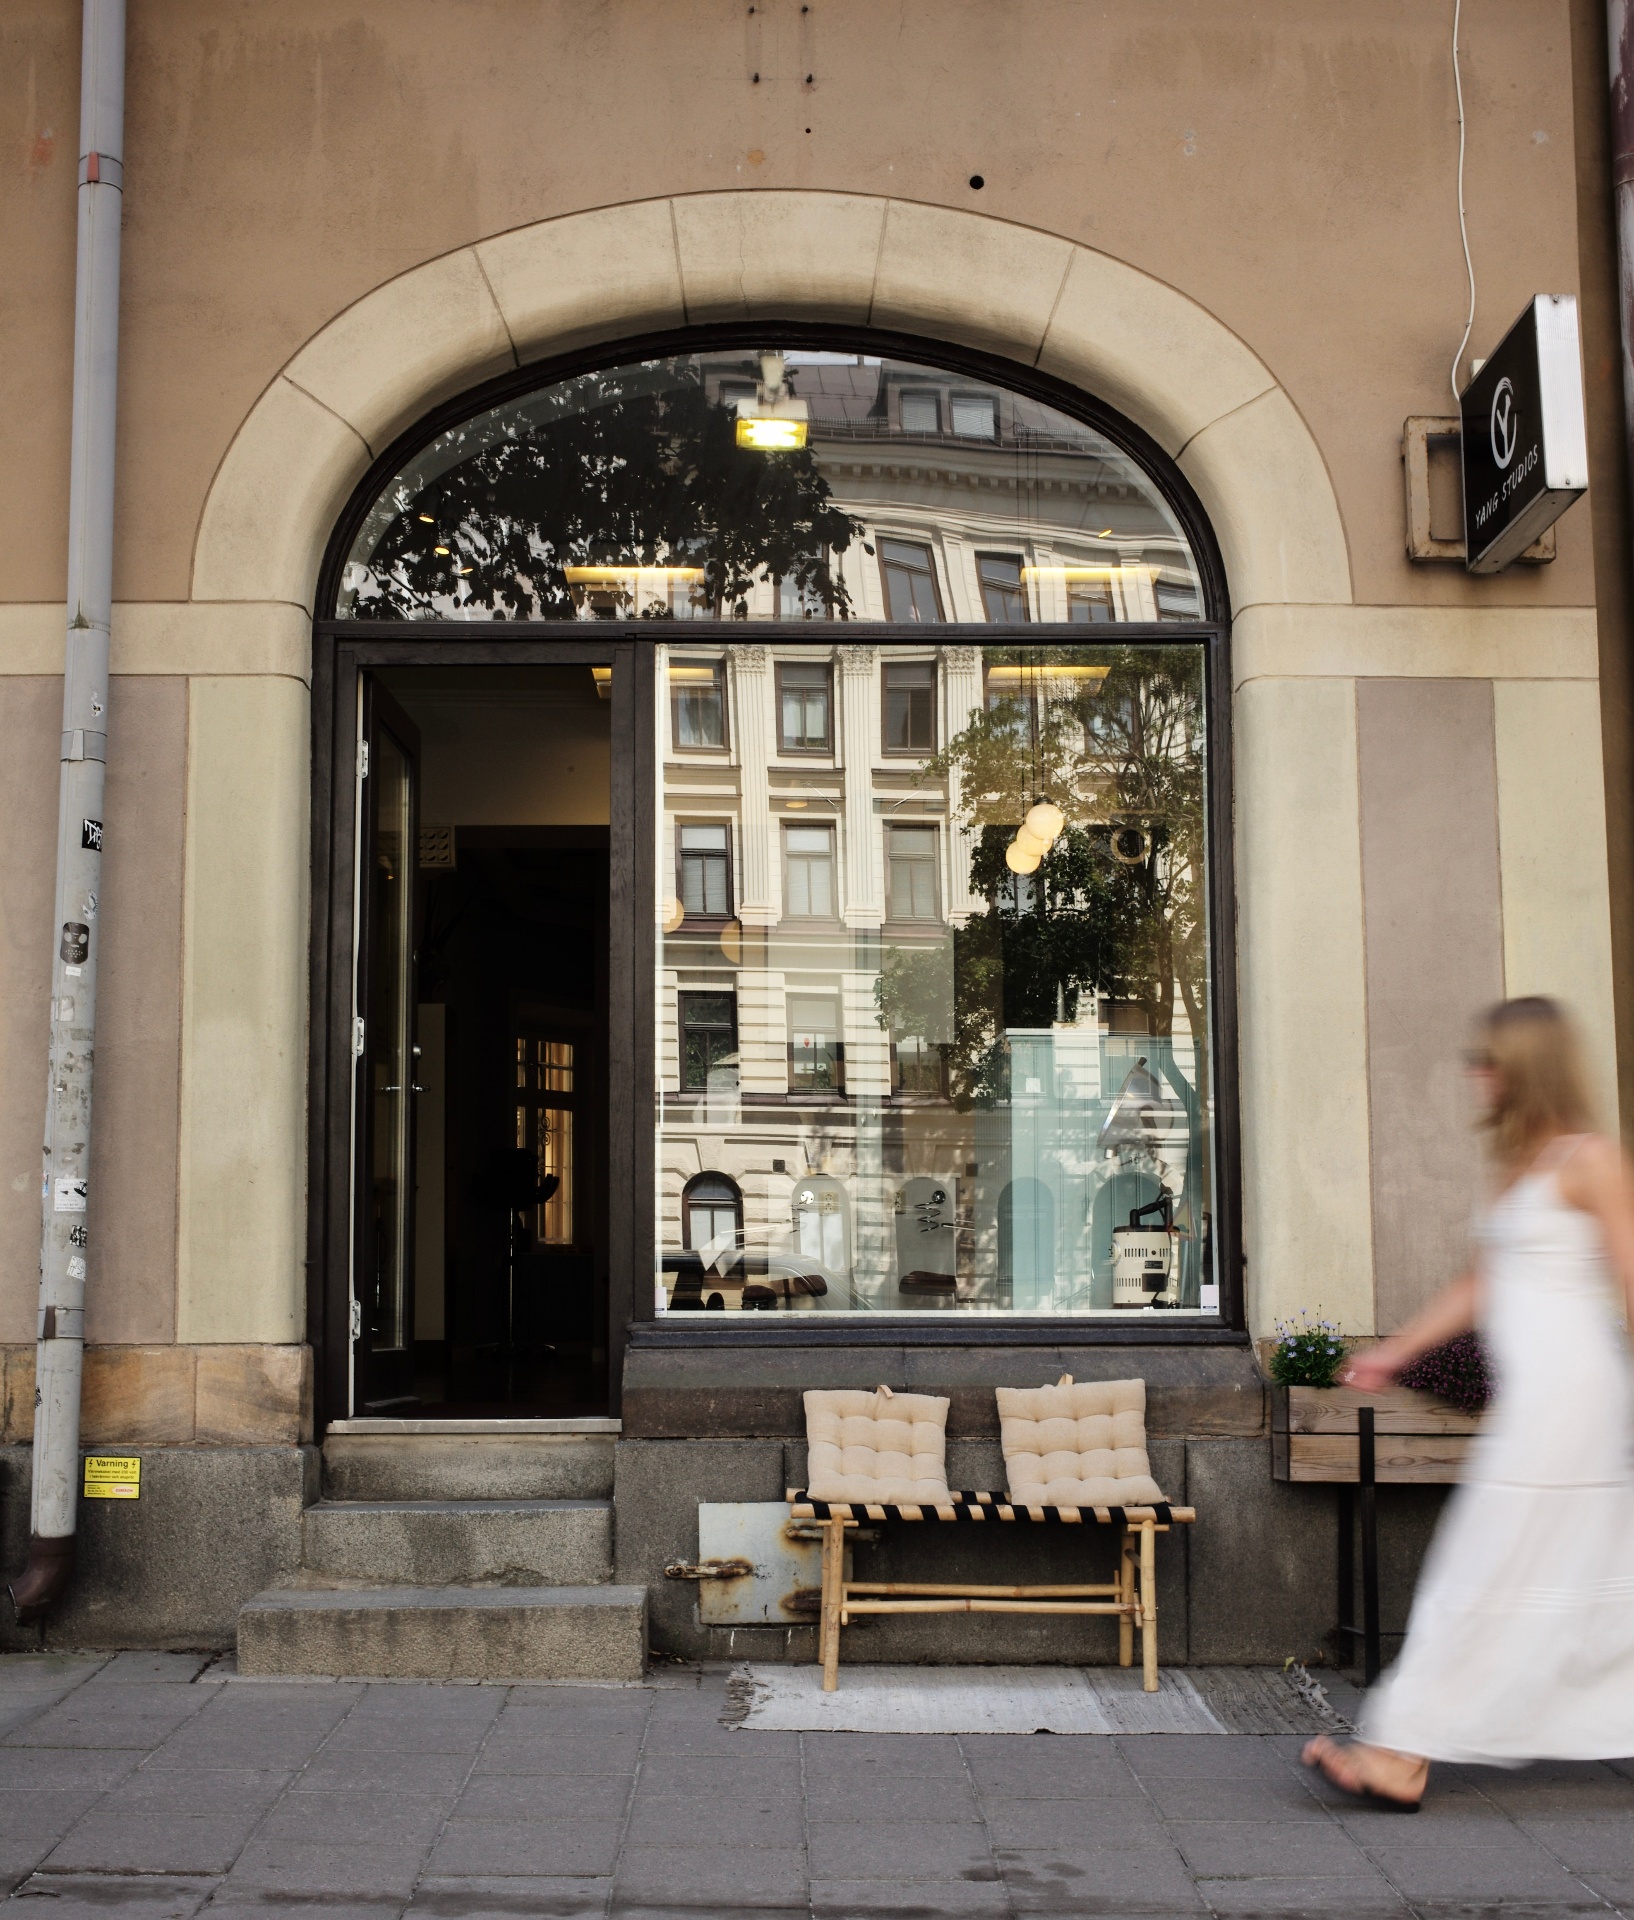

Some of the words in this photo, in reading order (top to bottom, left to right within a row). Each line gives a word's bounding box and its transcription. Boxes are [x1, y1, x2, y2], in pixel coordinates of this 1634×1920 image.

[1475, 491, 1499, 530] YANG
[1501, 444, 1538, 502] STUDIOS
[96, 1460, 128, 1469] Varning
